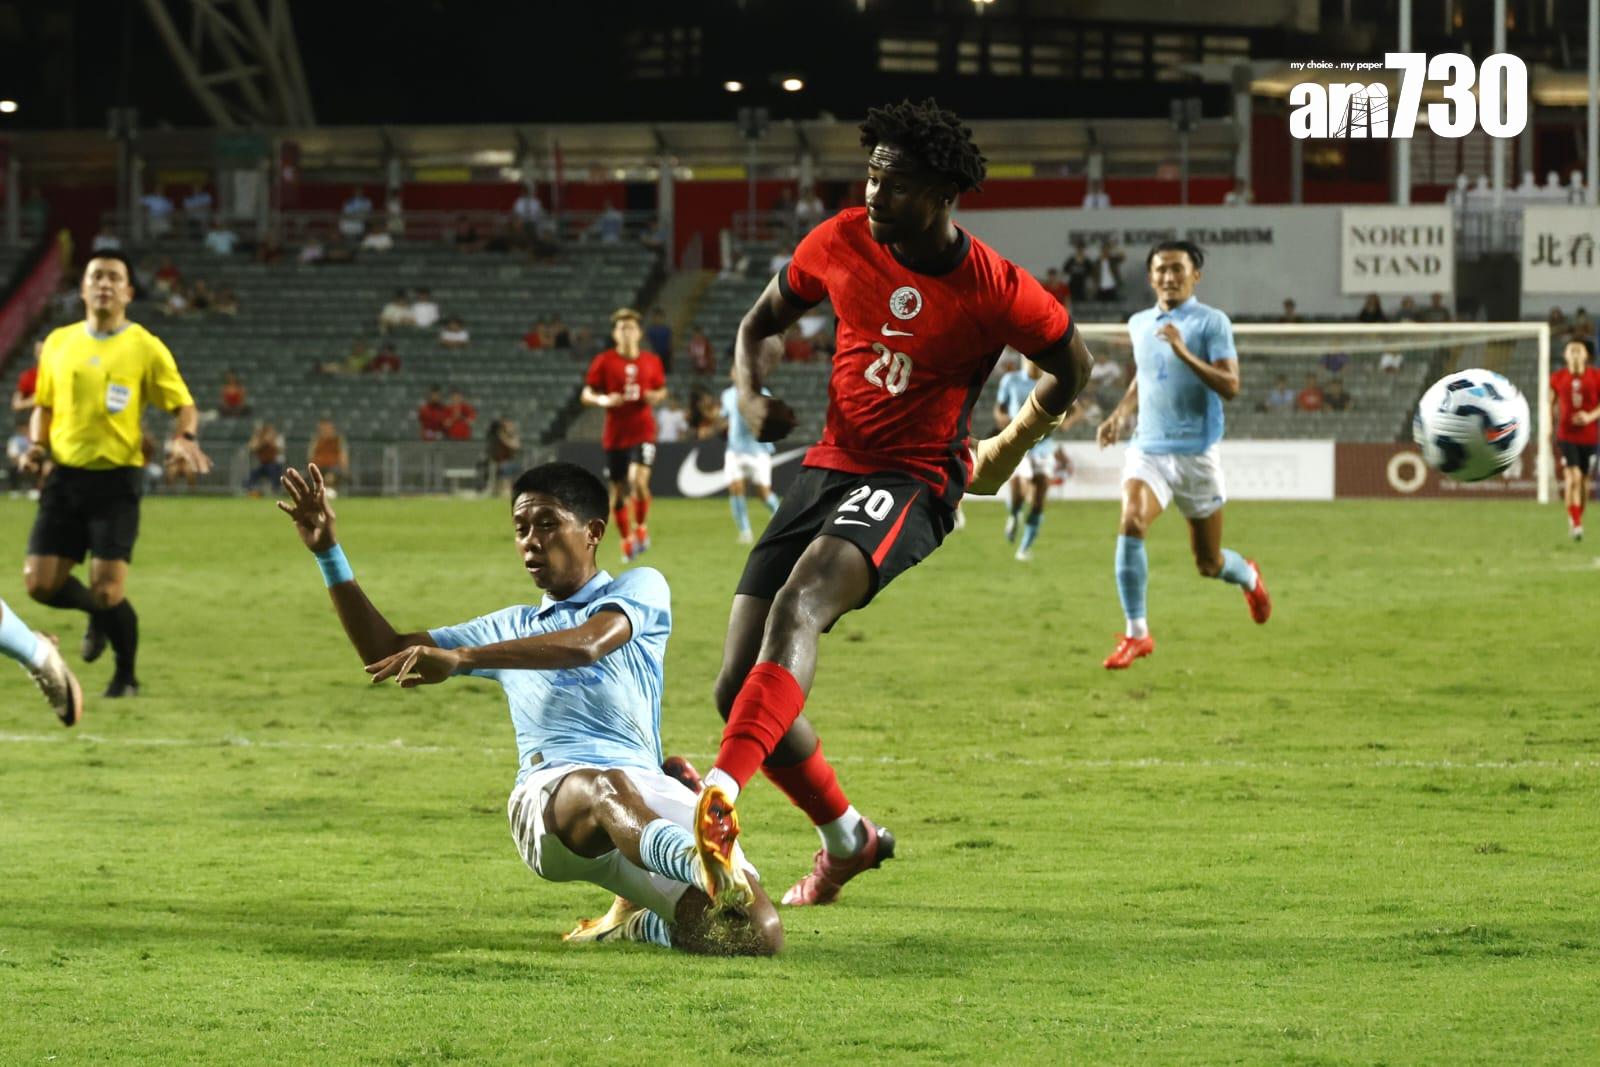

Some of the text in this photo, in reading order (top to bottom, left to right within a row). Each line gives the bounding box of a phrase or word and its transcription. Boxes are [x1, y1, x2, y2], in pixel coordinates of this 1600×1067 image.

[1186, 227, 1274, 245] STADIUM
[1351, 225, 1446, 248] NORTH
[1353, 253, 1442, 276] STAND
[863, 342, 913, 396] 20
[837, 484, 895, 521] 20
